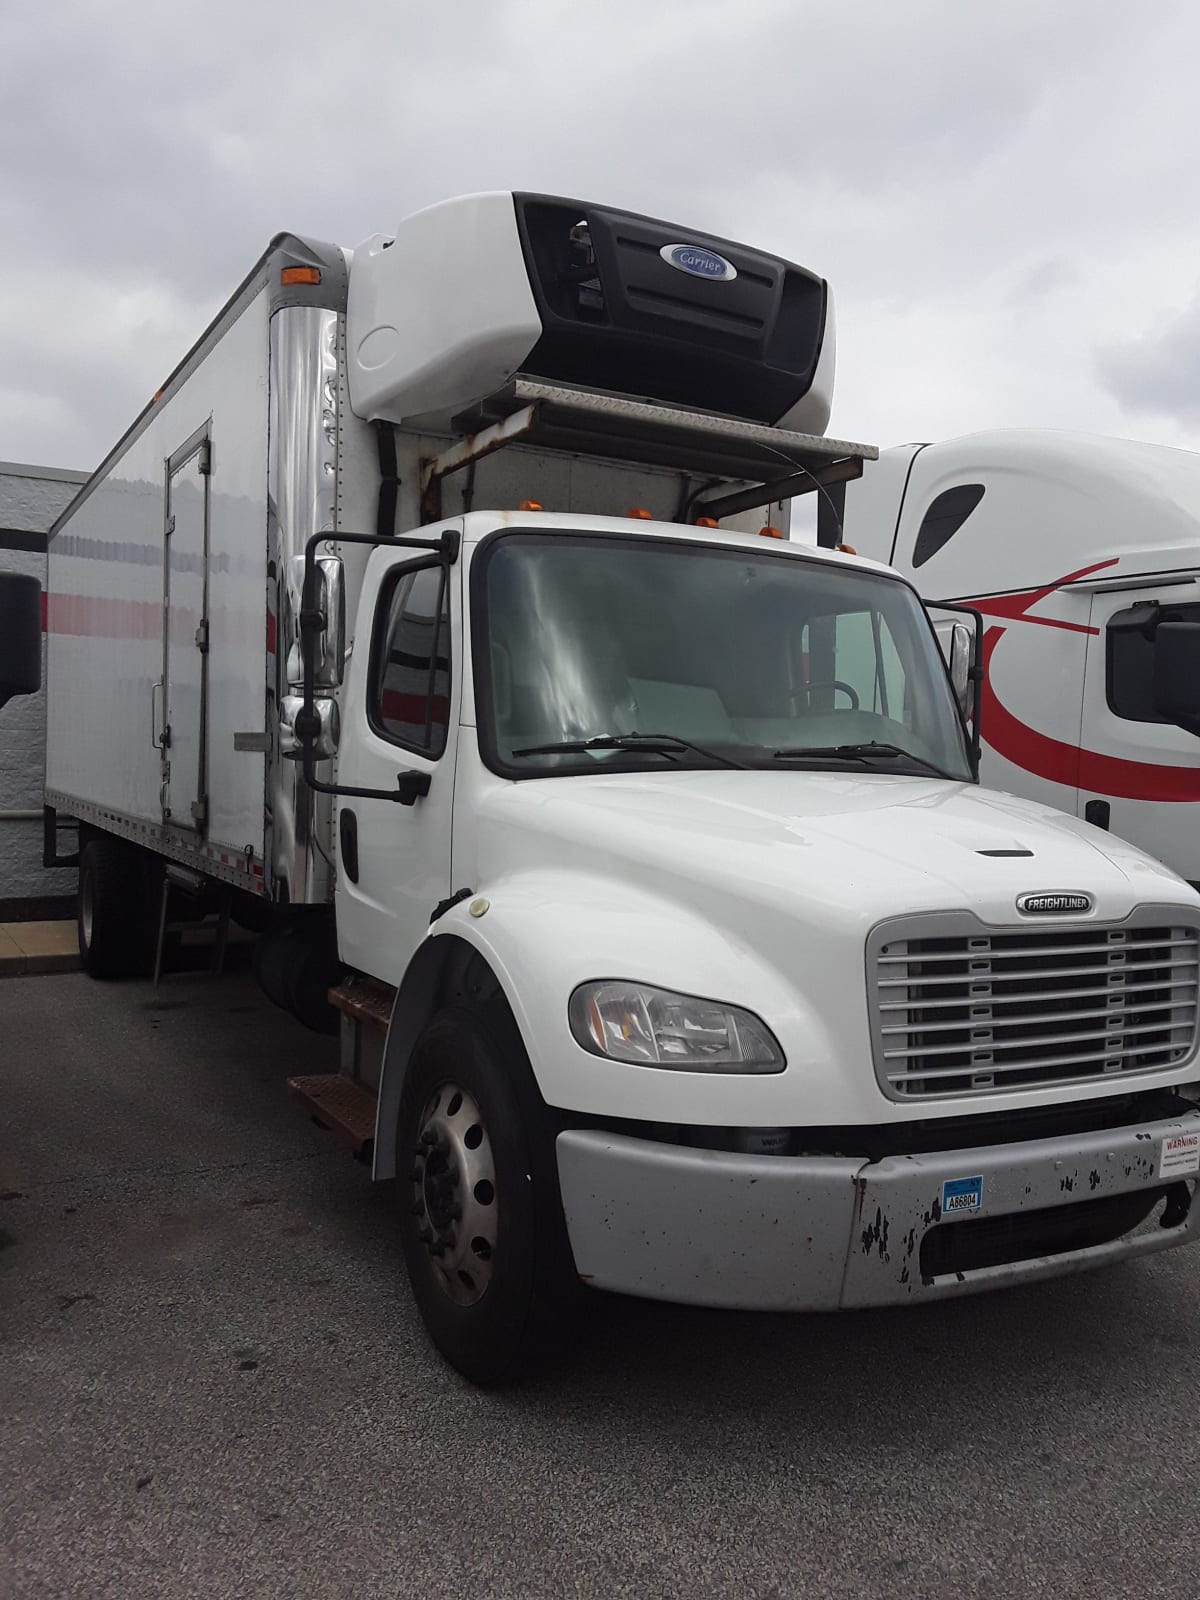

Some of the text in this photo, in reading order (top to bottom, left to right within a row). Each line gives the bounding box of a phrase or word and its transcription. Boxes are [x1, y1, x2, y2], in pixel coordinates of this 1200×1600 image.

[680, 252, 721, 271] Carrier
[1028, 897, 1087, 910] FREIGHTLINER
[1167, 1136, 1198, 1150] WARNING
